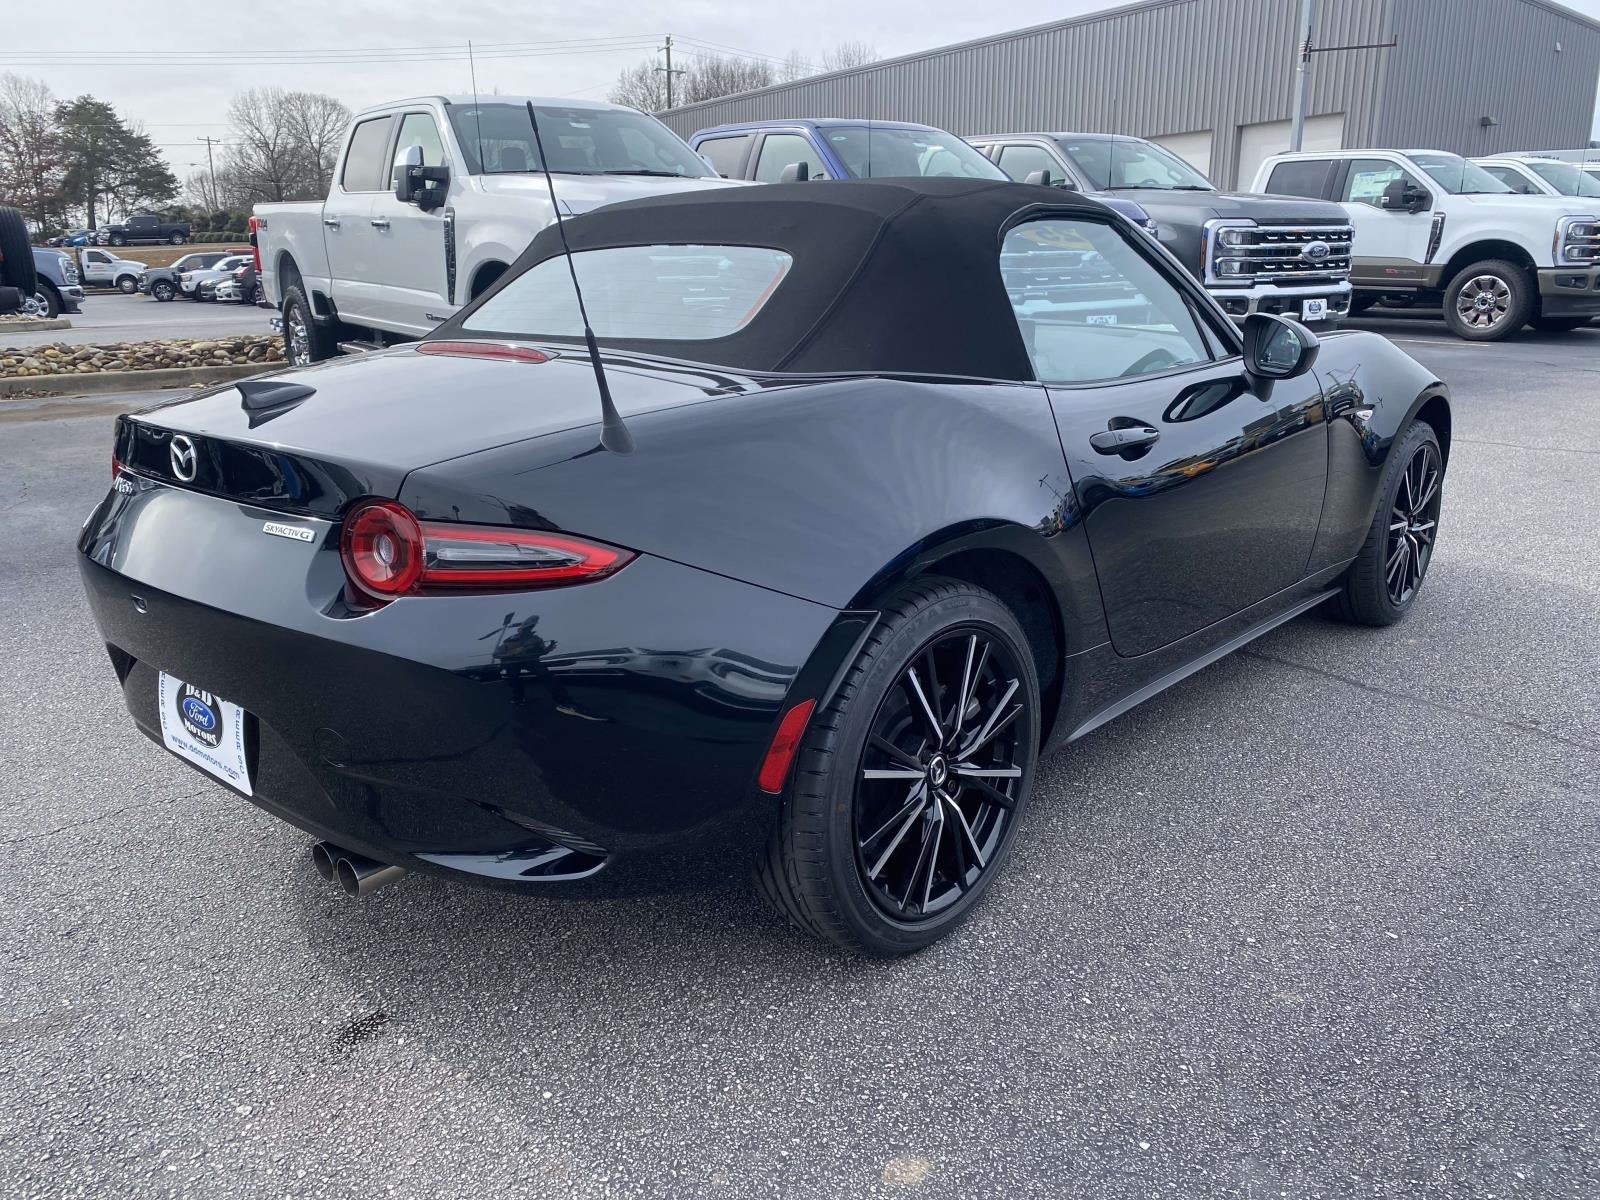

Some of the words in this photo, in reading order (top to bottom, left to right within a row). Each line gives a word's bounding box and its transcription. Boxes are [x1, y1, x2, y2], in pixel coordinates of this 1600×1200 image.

[185, 683, 213, 707] D&D
[188, 702, 209, 727] Ford
[184, 717, 218, 746] MOTORS
